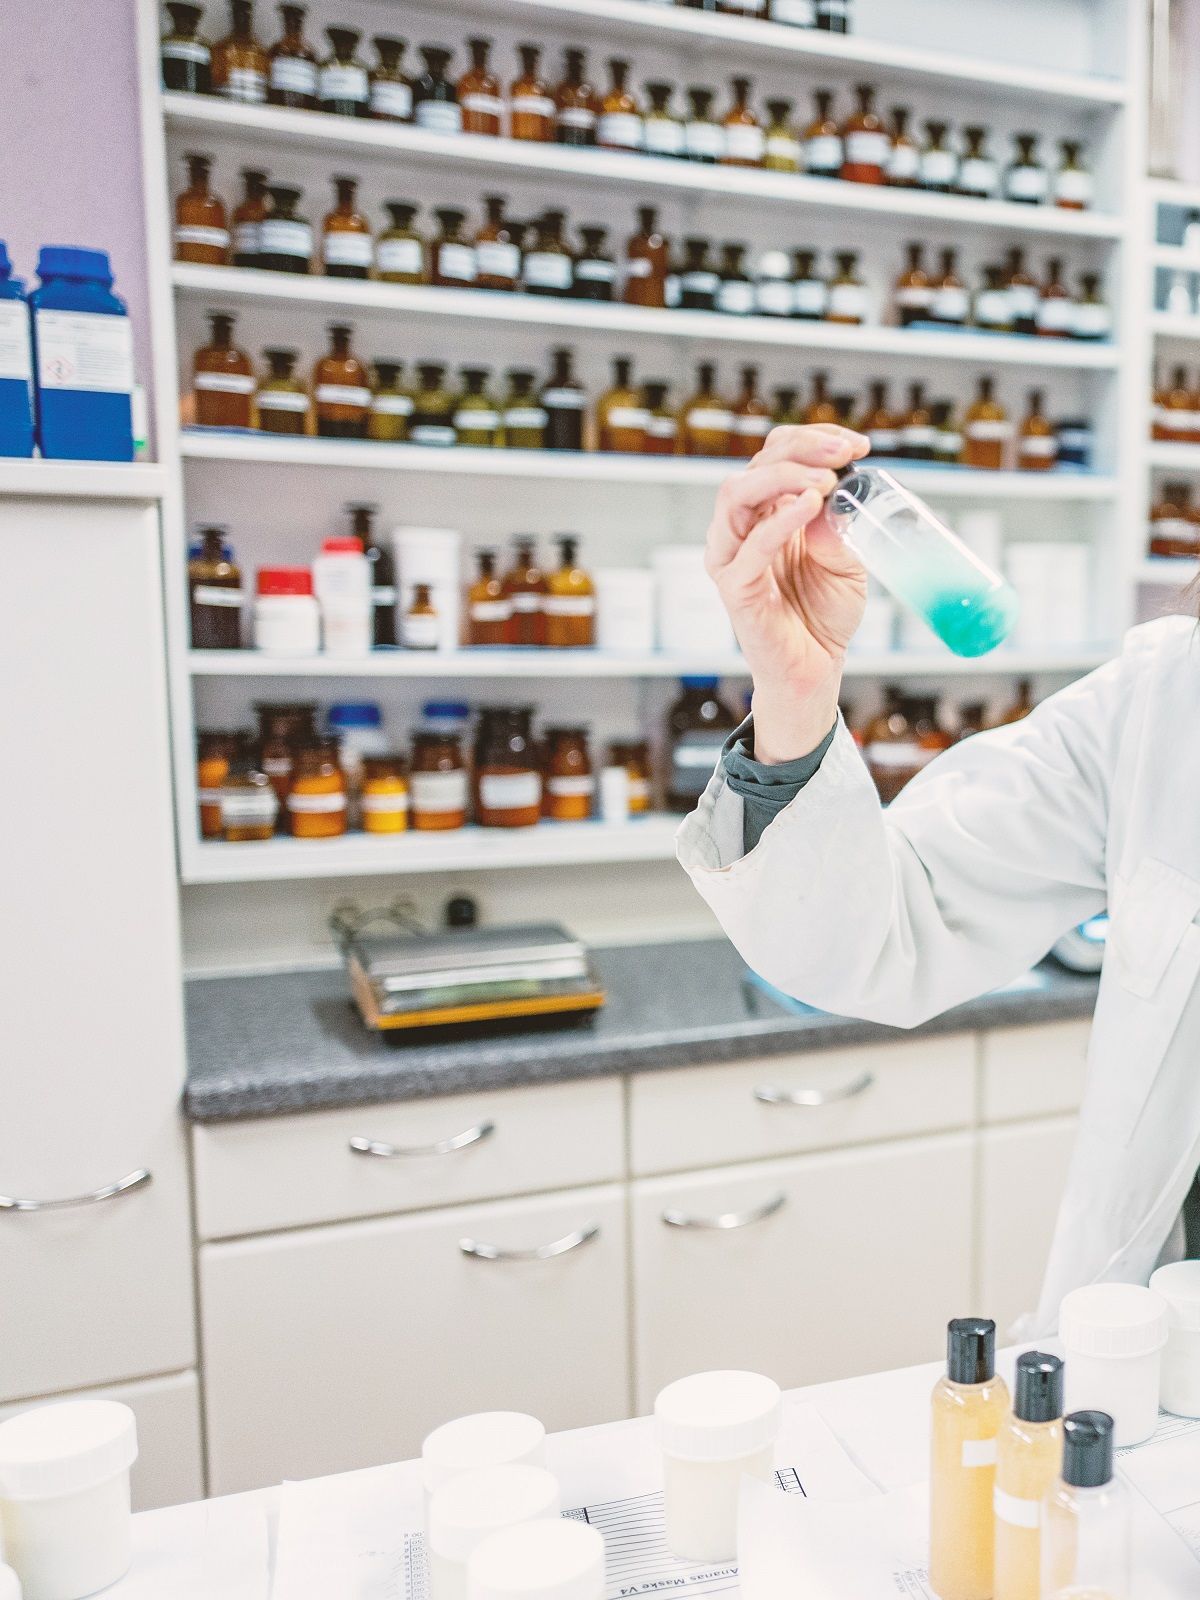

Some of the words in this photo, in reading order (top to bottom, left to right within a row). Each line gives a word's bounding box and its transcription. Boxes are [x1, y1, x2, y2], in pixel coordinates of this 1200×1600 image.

[689, 1568, 739, 1581] Ananas
[641, 1578, 685, 1589] Maske
[620, 1586, 638, 1595] V4
